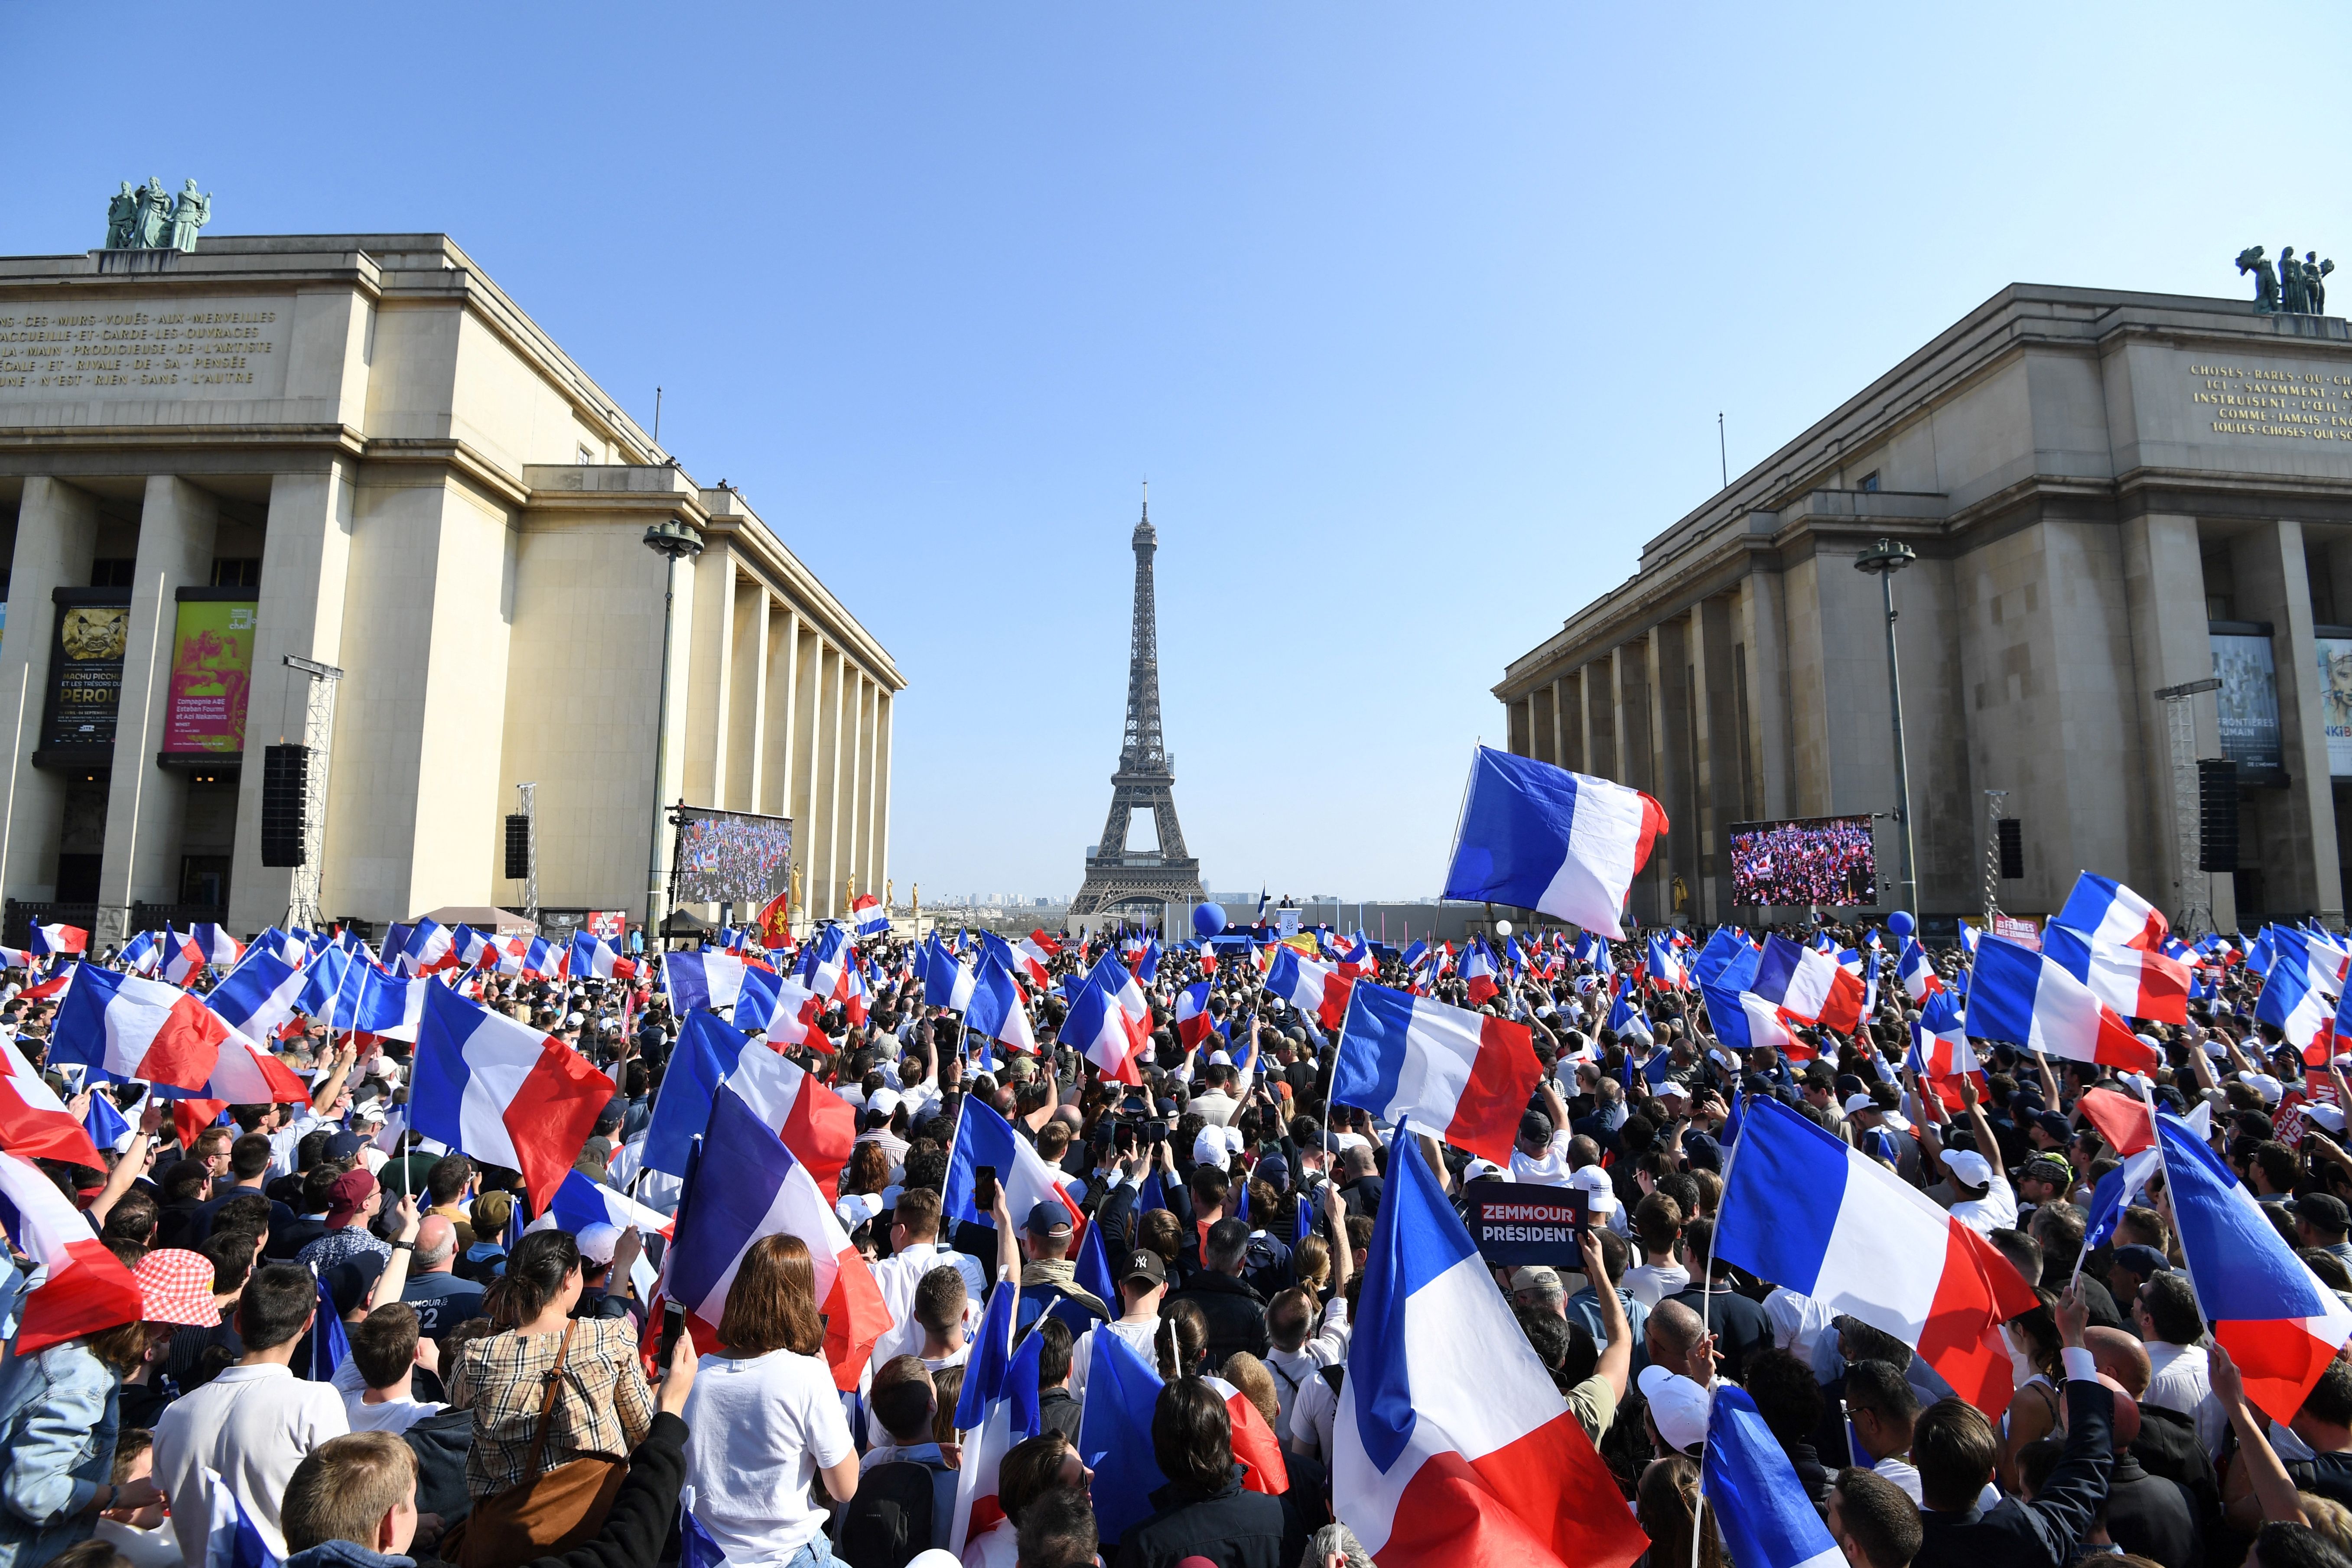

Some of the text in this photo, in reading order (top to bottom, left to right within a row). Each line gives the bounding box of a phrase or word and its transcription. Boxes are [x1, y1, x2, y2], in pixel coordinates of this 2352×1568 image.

[24, 317, 49, 326] CES
[59, 316, 96, 326] MURS
[105, 313, 149, 325] VOUÉS
[159, 314, 184, 324] AUX
[193, 312, 276, 323] MERVEILLES
[0, 328, 259, 342] ACCUEILLE ET GARDE LES OUVRAGES
[2, 342, 272, 357] LA MAIN PRODIGIEUSE DE L'ARTISTE
[48, 361, 65, 371] ET
[76, 360, 121, 370] RIVALE
[134, 359, 151, 370] DE
[164, 359, 180, 369] SA
[194, 356, 247, 368] PENSÉE
[41, 375, 82, 386] N'EST
[95, 374, 128, 385] RIEN
[141, 374, 178, 384] SANS
[192, 373, 254, 384] L'AUTRE
[2191, 365, 2352, 386] CHOSES RARES OU CH
[2206, 379, 2226, 390] ICI
[2245, 383, 2325, 397] SAVAMMENT
[2193, 392, 2338, 412] INSTRUISENT L'ŒIL
[2219, 408, 2267, 421] COMME
[2278, 413, 2320, 425] JAMAIS
[2211, 422, 2255, 434] TOUTES
[2262, 425, 2306, 437] CHOSES
[2313, 429, 2333, 439] QUI
[60, 687, 120, 703] PÉROU
[1996, 920, 2034, 932] LES FEMMES
[2272, 1102, 2298, 1140] VOYON
[1483, 1205, 1573, 1222] ZEMMOUR
[1483, 1224, 1575, 1242] PRÉSIDENT
[403, 1299, 441, 1308] MMOUR
